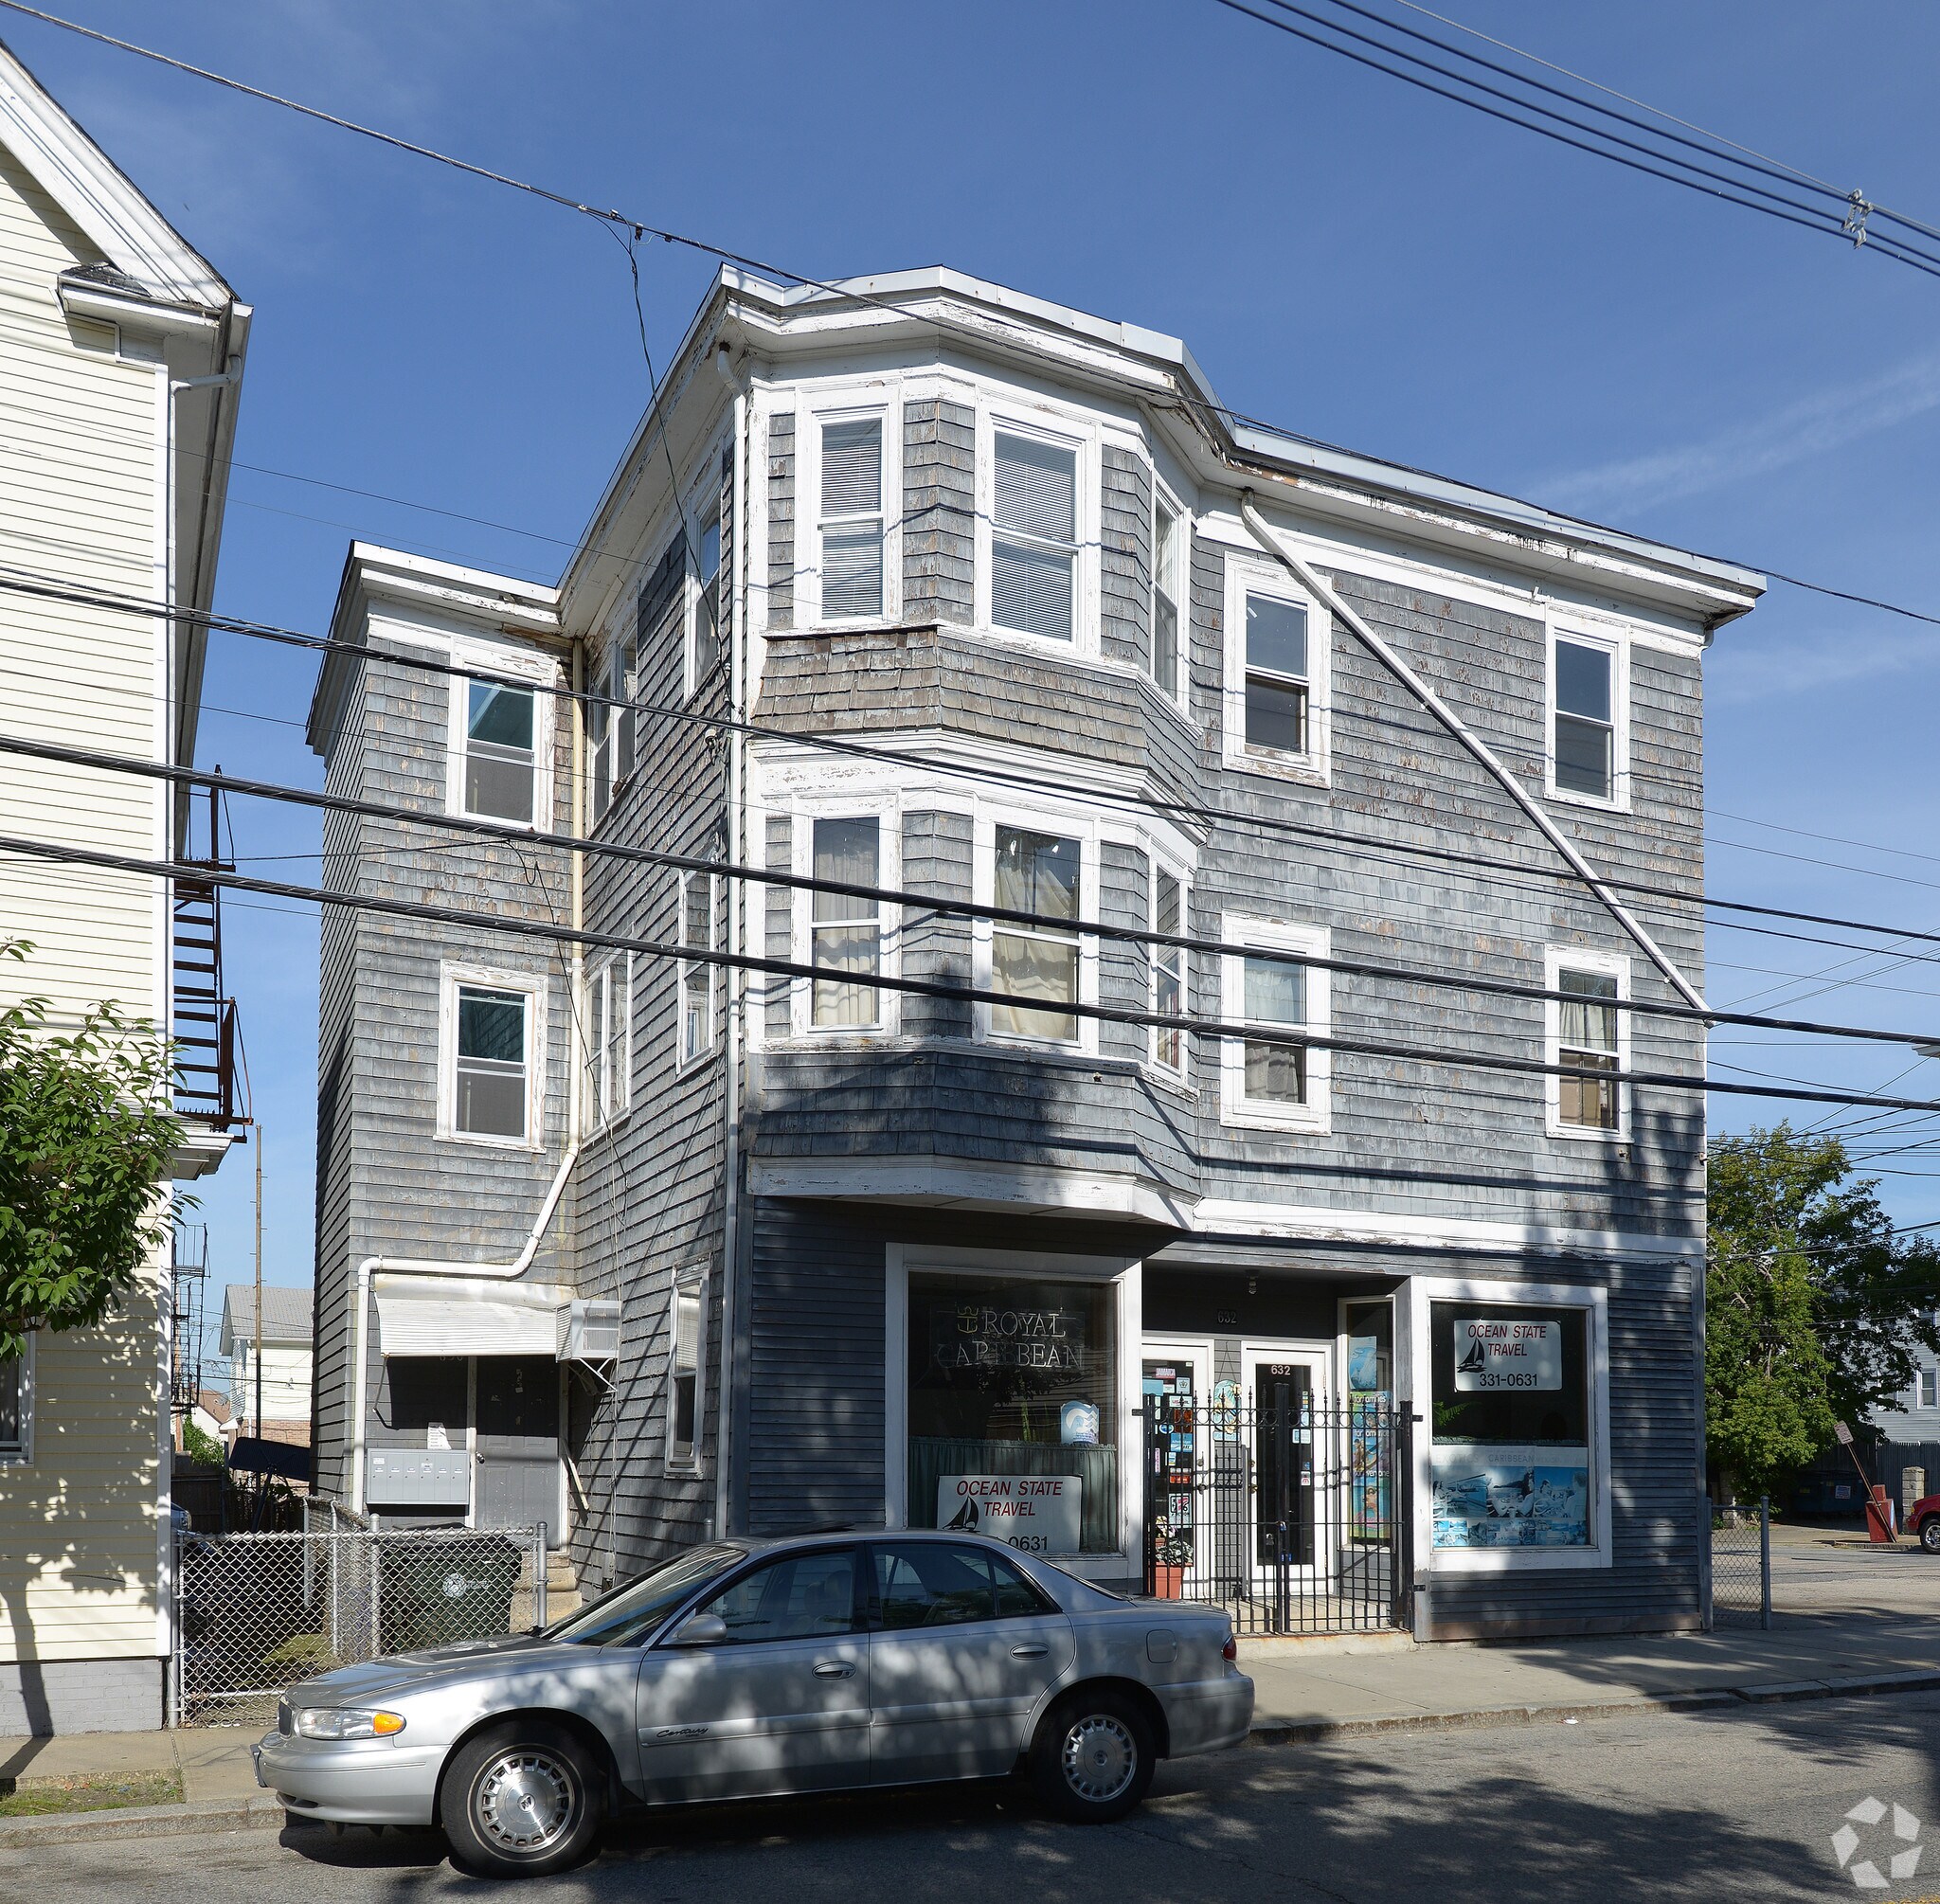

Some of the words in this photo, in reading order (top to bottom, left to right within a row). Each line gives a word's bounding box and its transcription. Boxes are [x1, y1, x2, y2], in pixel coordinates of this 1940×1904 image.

[1217, 1310, 1237, 1323] 632
[981, 1311, 1066, 1338] ROYAL
[1467, 1324, 1508, 1338] OCEAN
[1513, 1325, 1547, 1338] STATE
[1488, 1343, 1528, 1356] TRAVEL
[1271, 1364, 1291, 1375] 632
[1479, 1374, 1538, 1387] 331-0631
[1488, 1453, 1535, 1463] CARIBBEAN
[956, 1480, 1012, 1496] OCEAN
[1017, 1481, 1064, 1496] STATE
[984, 1501, 1036, 1517] TRAVEL
[656, 1728, 710, 1738] Century
